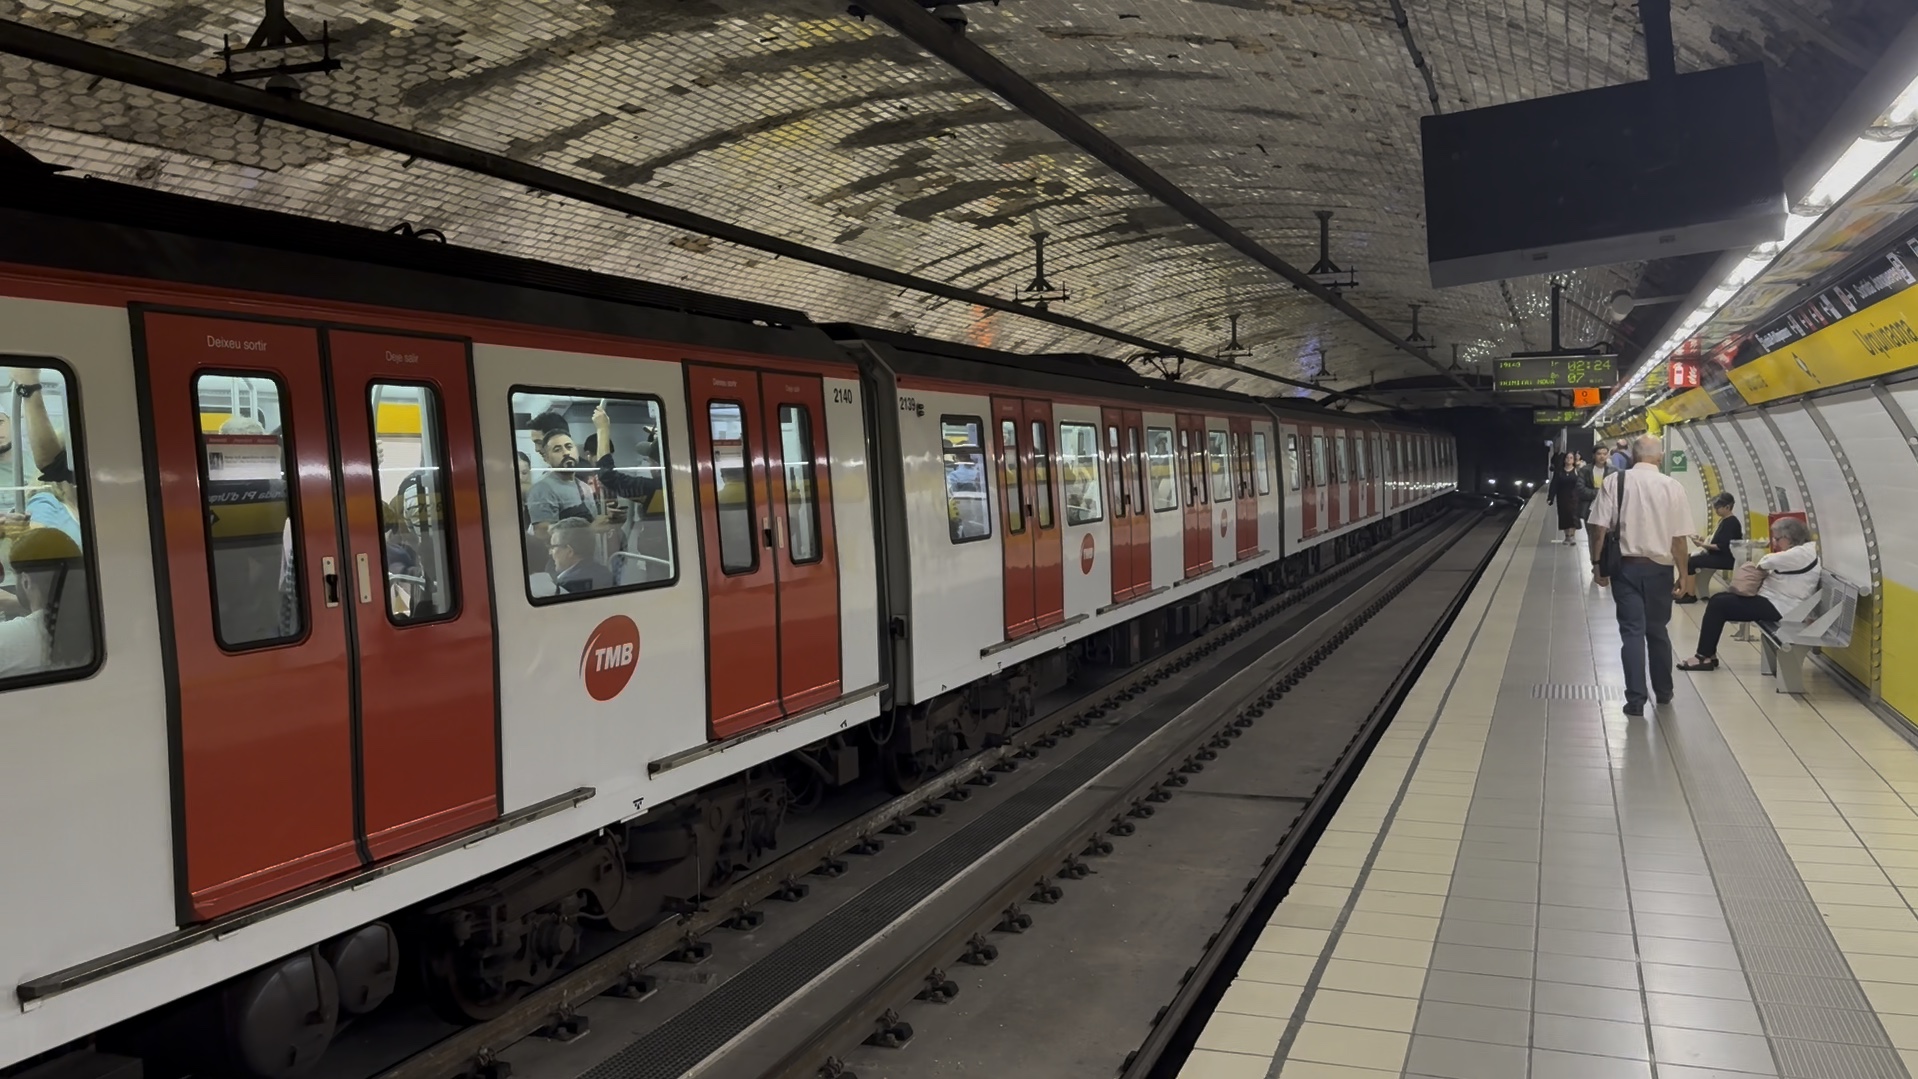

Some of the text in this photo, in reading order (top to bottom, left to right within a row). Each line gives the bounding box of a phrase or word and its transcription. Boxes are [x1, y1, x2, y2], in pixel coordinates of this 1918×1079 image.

[207, 335, 267, 351] Deixeu sortir
[1567, 360, 1612, 372] 02:24
[1567, 372, 1585, 384] 07
[833, 387, 853, 404] 2140
[900, 395, 916, 412] 2139
[595, 642, 634, 672] TMB
